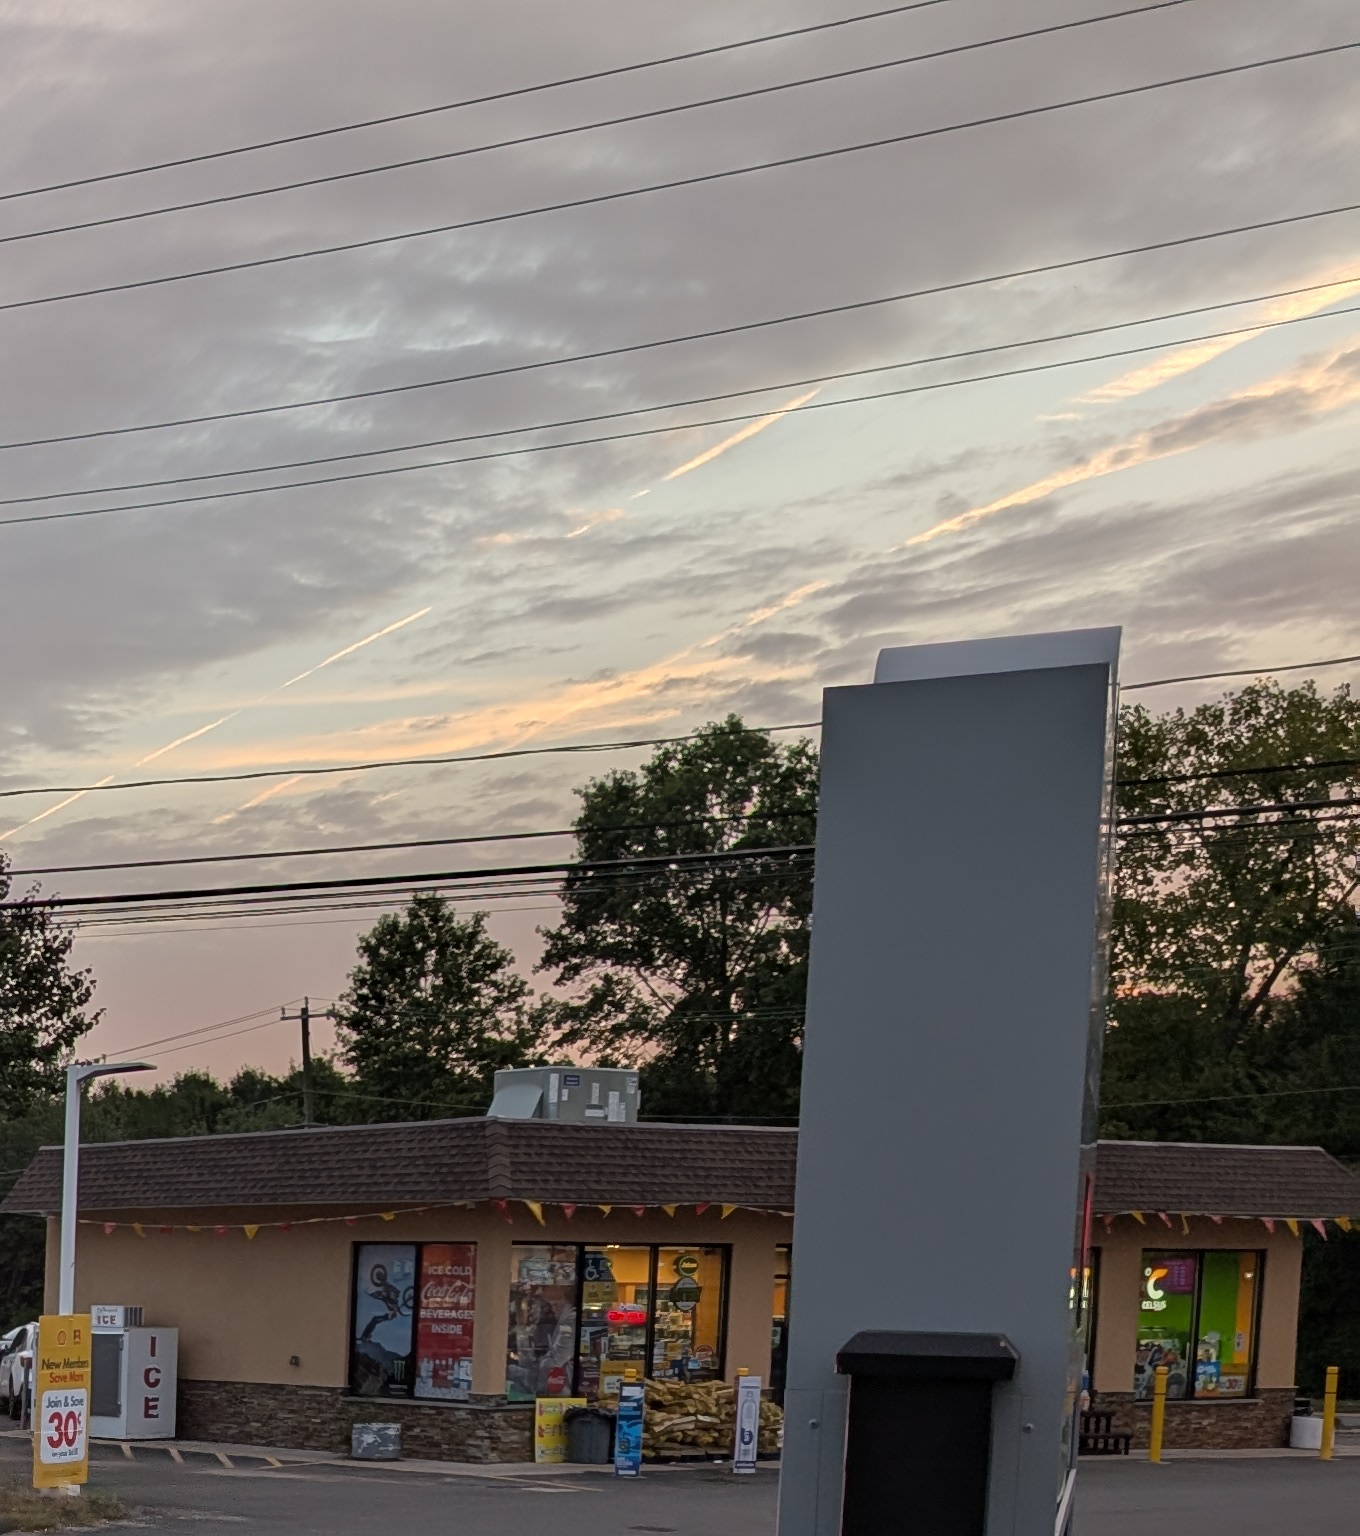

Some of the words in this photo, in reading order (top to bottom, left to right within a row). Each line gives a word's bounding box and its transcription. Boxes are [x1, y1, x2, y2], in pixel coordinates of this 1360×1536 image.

[429, 1266, 444, 1275] ICE
[445, 1266, 472, 1275] COLD
[97, 1314, 117, 1325] ICE
[420, 1309, 476, 1319] BEVERAGES
[431, 1324, 463, 1334] INSIDE
[42, 1358, 62, 1370] New
[49, 1371, 68, 1383] Save
[143, 1335, 161, 1418] ICE
[46, 1396, 62, 1408] Join
[63, 1396, 69, 1407] &
[70, 1396, 85, 1407] Save
